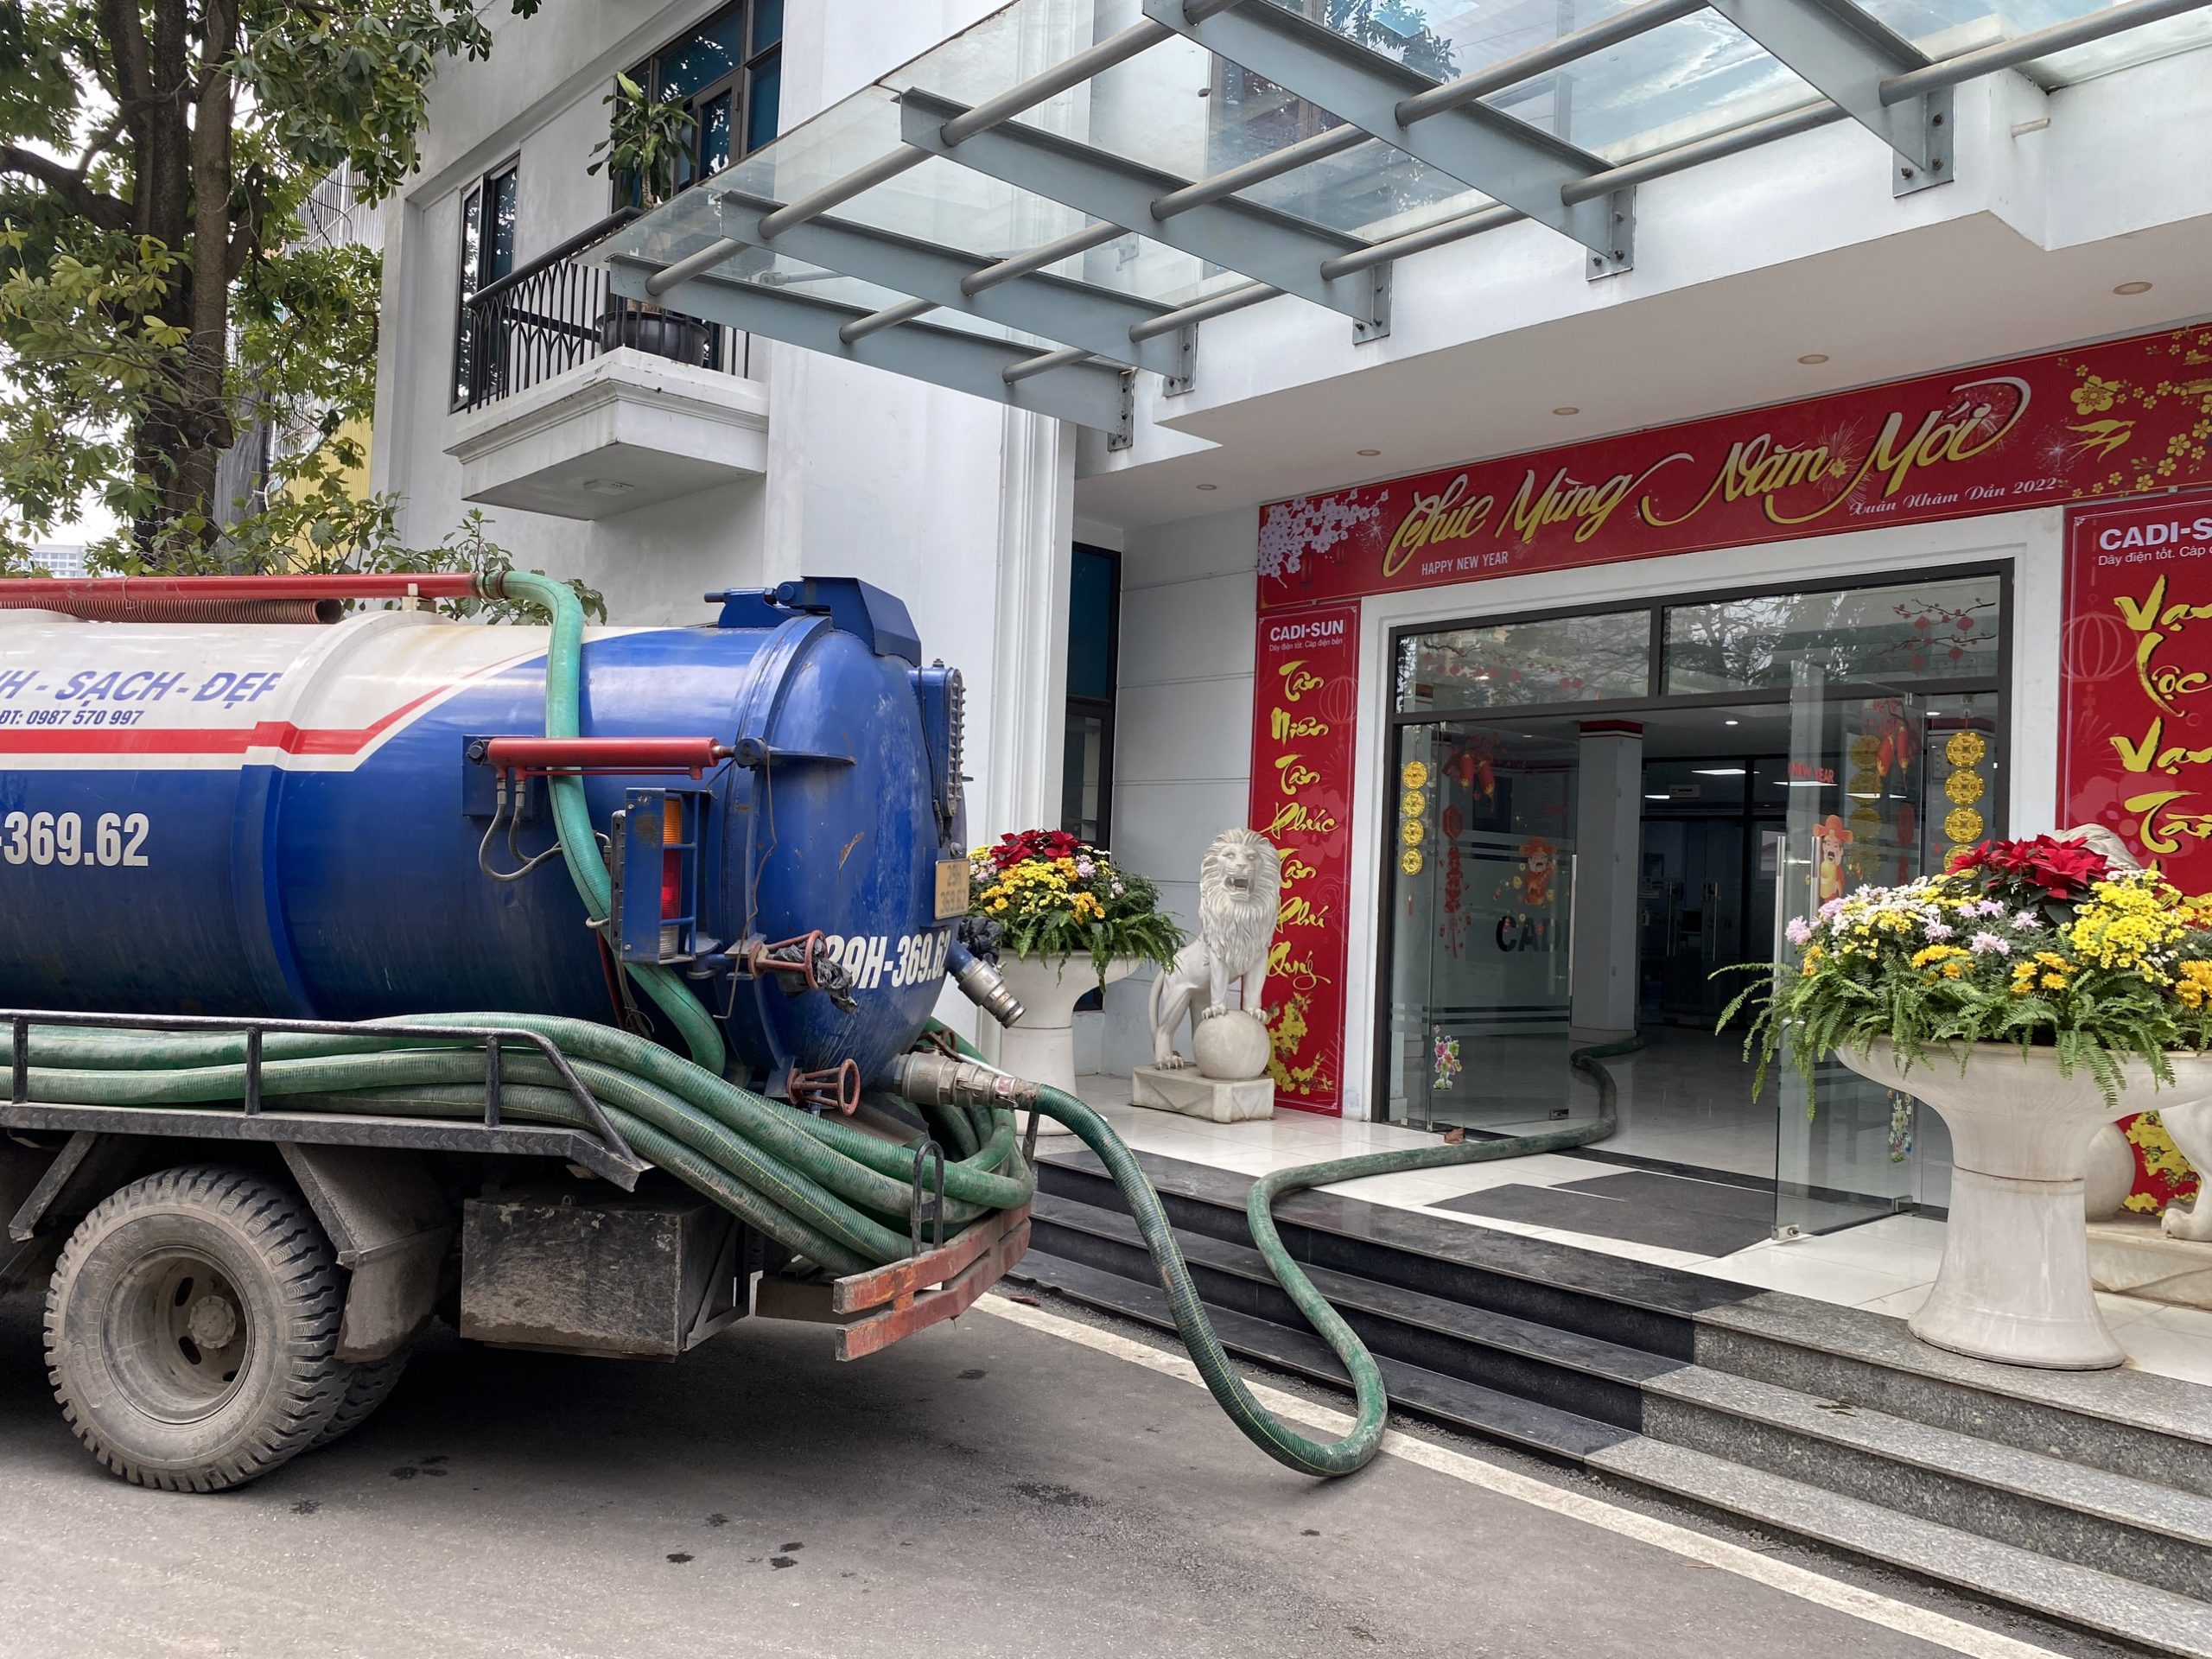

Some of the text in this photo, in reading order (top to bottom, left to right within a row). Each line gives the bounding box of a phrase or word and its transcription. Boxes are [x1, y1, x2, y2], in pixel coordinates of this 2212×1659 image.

[1849, 501, 1897, 517] Xuân
[2012, 477, 2058, 495] 2022
[1382, 474, 1494, 578] Chúc
[1421, 550, 1509, 576] HAPPY NEW YEAR
[2098, 553, 2123, 567] Dây
[2125, 550, 2152, 564] điện
[2156, 546, 2176, 561] tốt.
[2179, 544, 2207, 558] Cáp
[1269, 619, 1344, 642] CADI-SUN
[54, 670, 187, 708] SẠCH
[26, 710, 71, 725] 0987
[72, 710, 107, 725] 570
[109, 710, 145, 725] 997
[0, 810, 150, 868] 369.62
